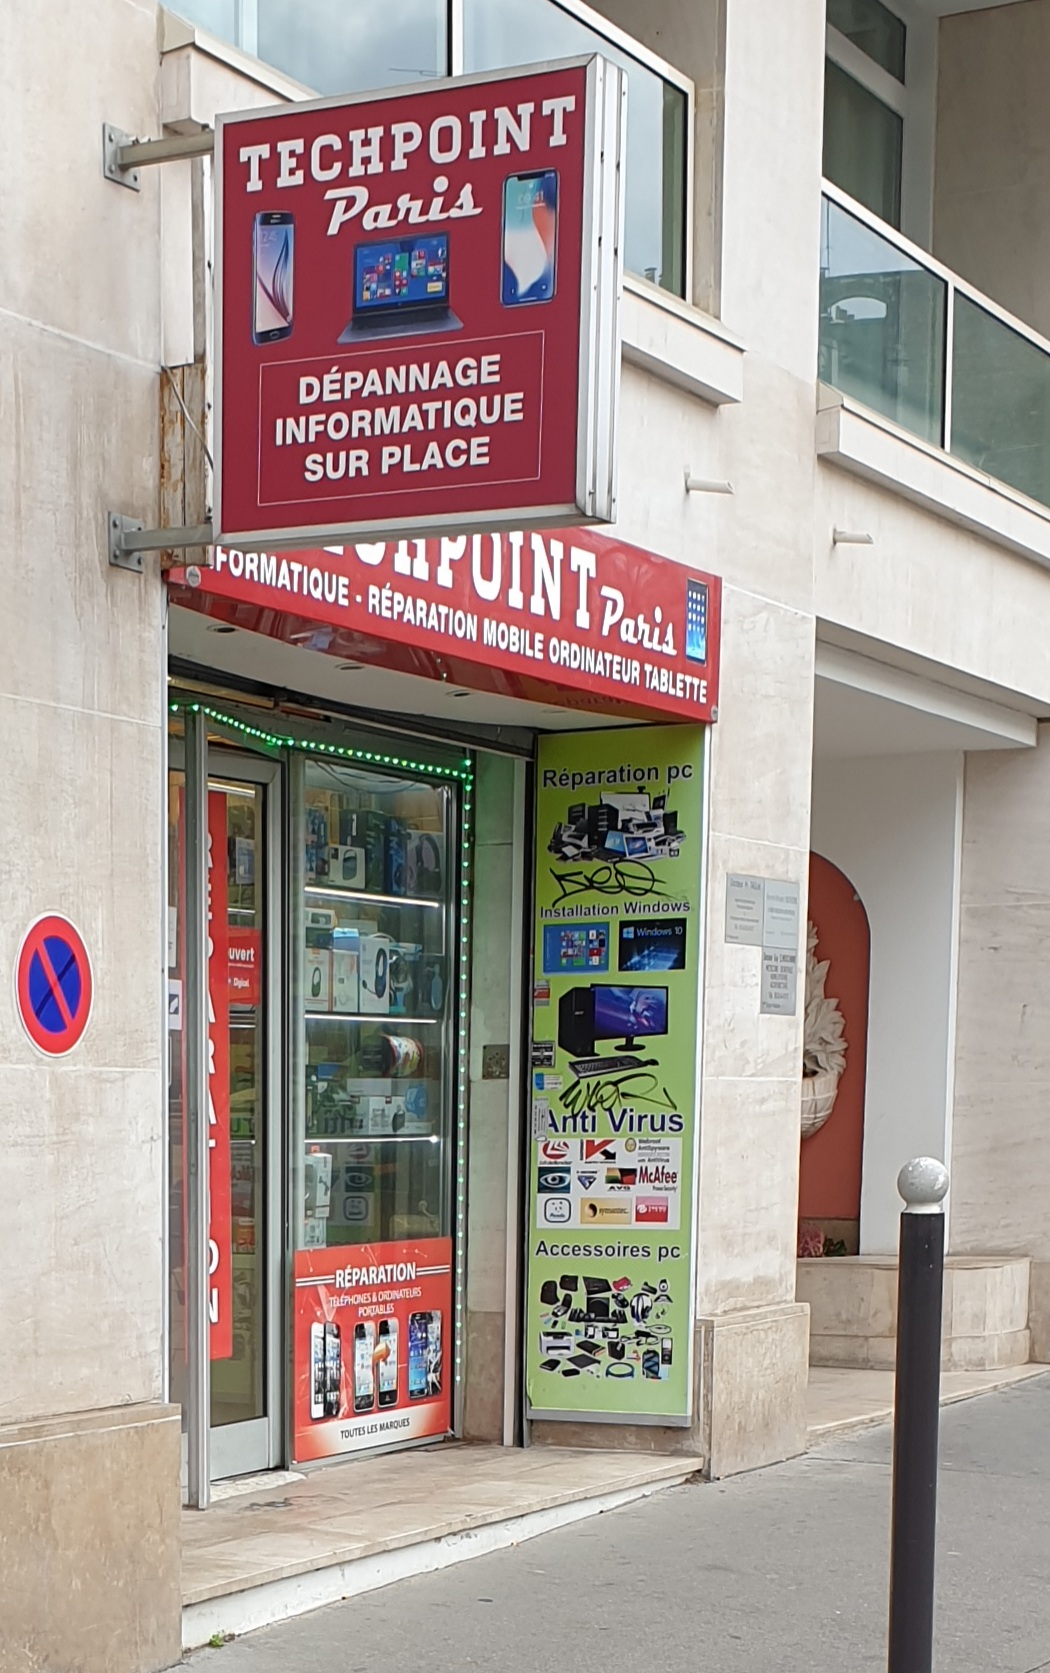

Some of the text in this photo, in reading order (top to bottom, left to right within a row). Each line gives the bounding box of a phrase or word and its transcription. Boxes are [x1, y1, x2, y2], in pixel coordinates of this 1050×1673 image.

[239, 95, 576, 192] TECHPOINT
[323, 175, 483, 236] Paris
[299, 354, 501, 405] DÉPANNAGE
[275, 392, 524, 446] INFORMATIQUE
[304, 436, 490, 483] SUR PLACE
[209, 545, 349, 607] FORMATIQUE
[368, 582, 477, 643] RÉPARATION
[483, 617, 544, 660] MOBILE
[549, 636, 640, 686] ORDINATEUR
[644, 663, 707, 703] TABLETTE
[601, 585, 677, 656] Paris
[543, 764, 693, 790] Réparation pc
[540, 901, 690, 919] Installation Windows
[636, 926, 683, 937] Windows 10
[229, 947, 255, 962] uvert
[607, 1108, 684, 1133] Virus
[638, 1165, 677, 1184] McAfee
[536, 1240, 681, 1262] Accessoires pc
[336, 1262, 416, 1288] RÉPARATION
[378, 1287, 421, 1301] ORDINATEURS
[358, 1303, 394, 1317] PORTABLES
[340, 1418, 410, 1439] TOUTES LES MARQUES
